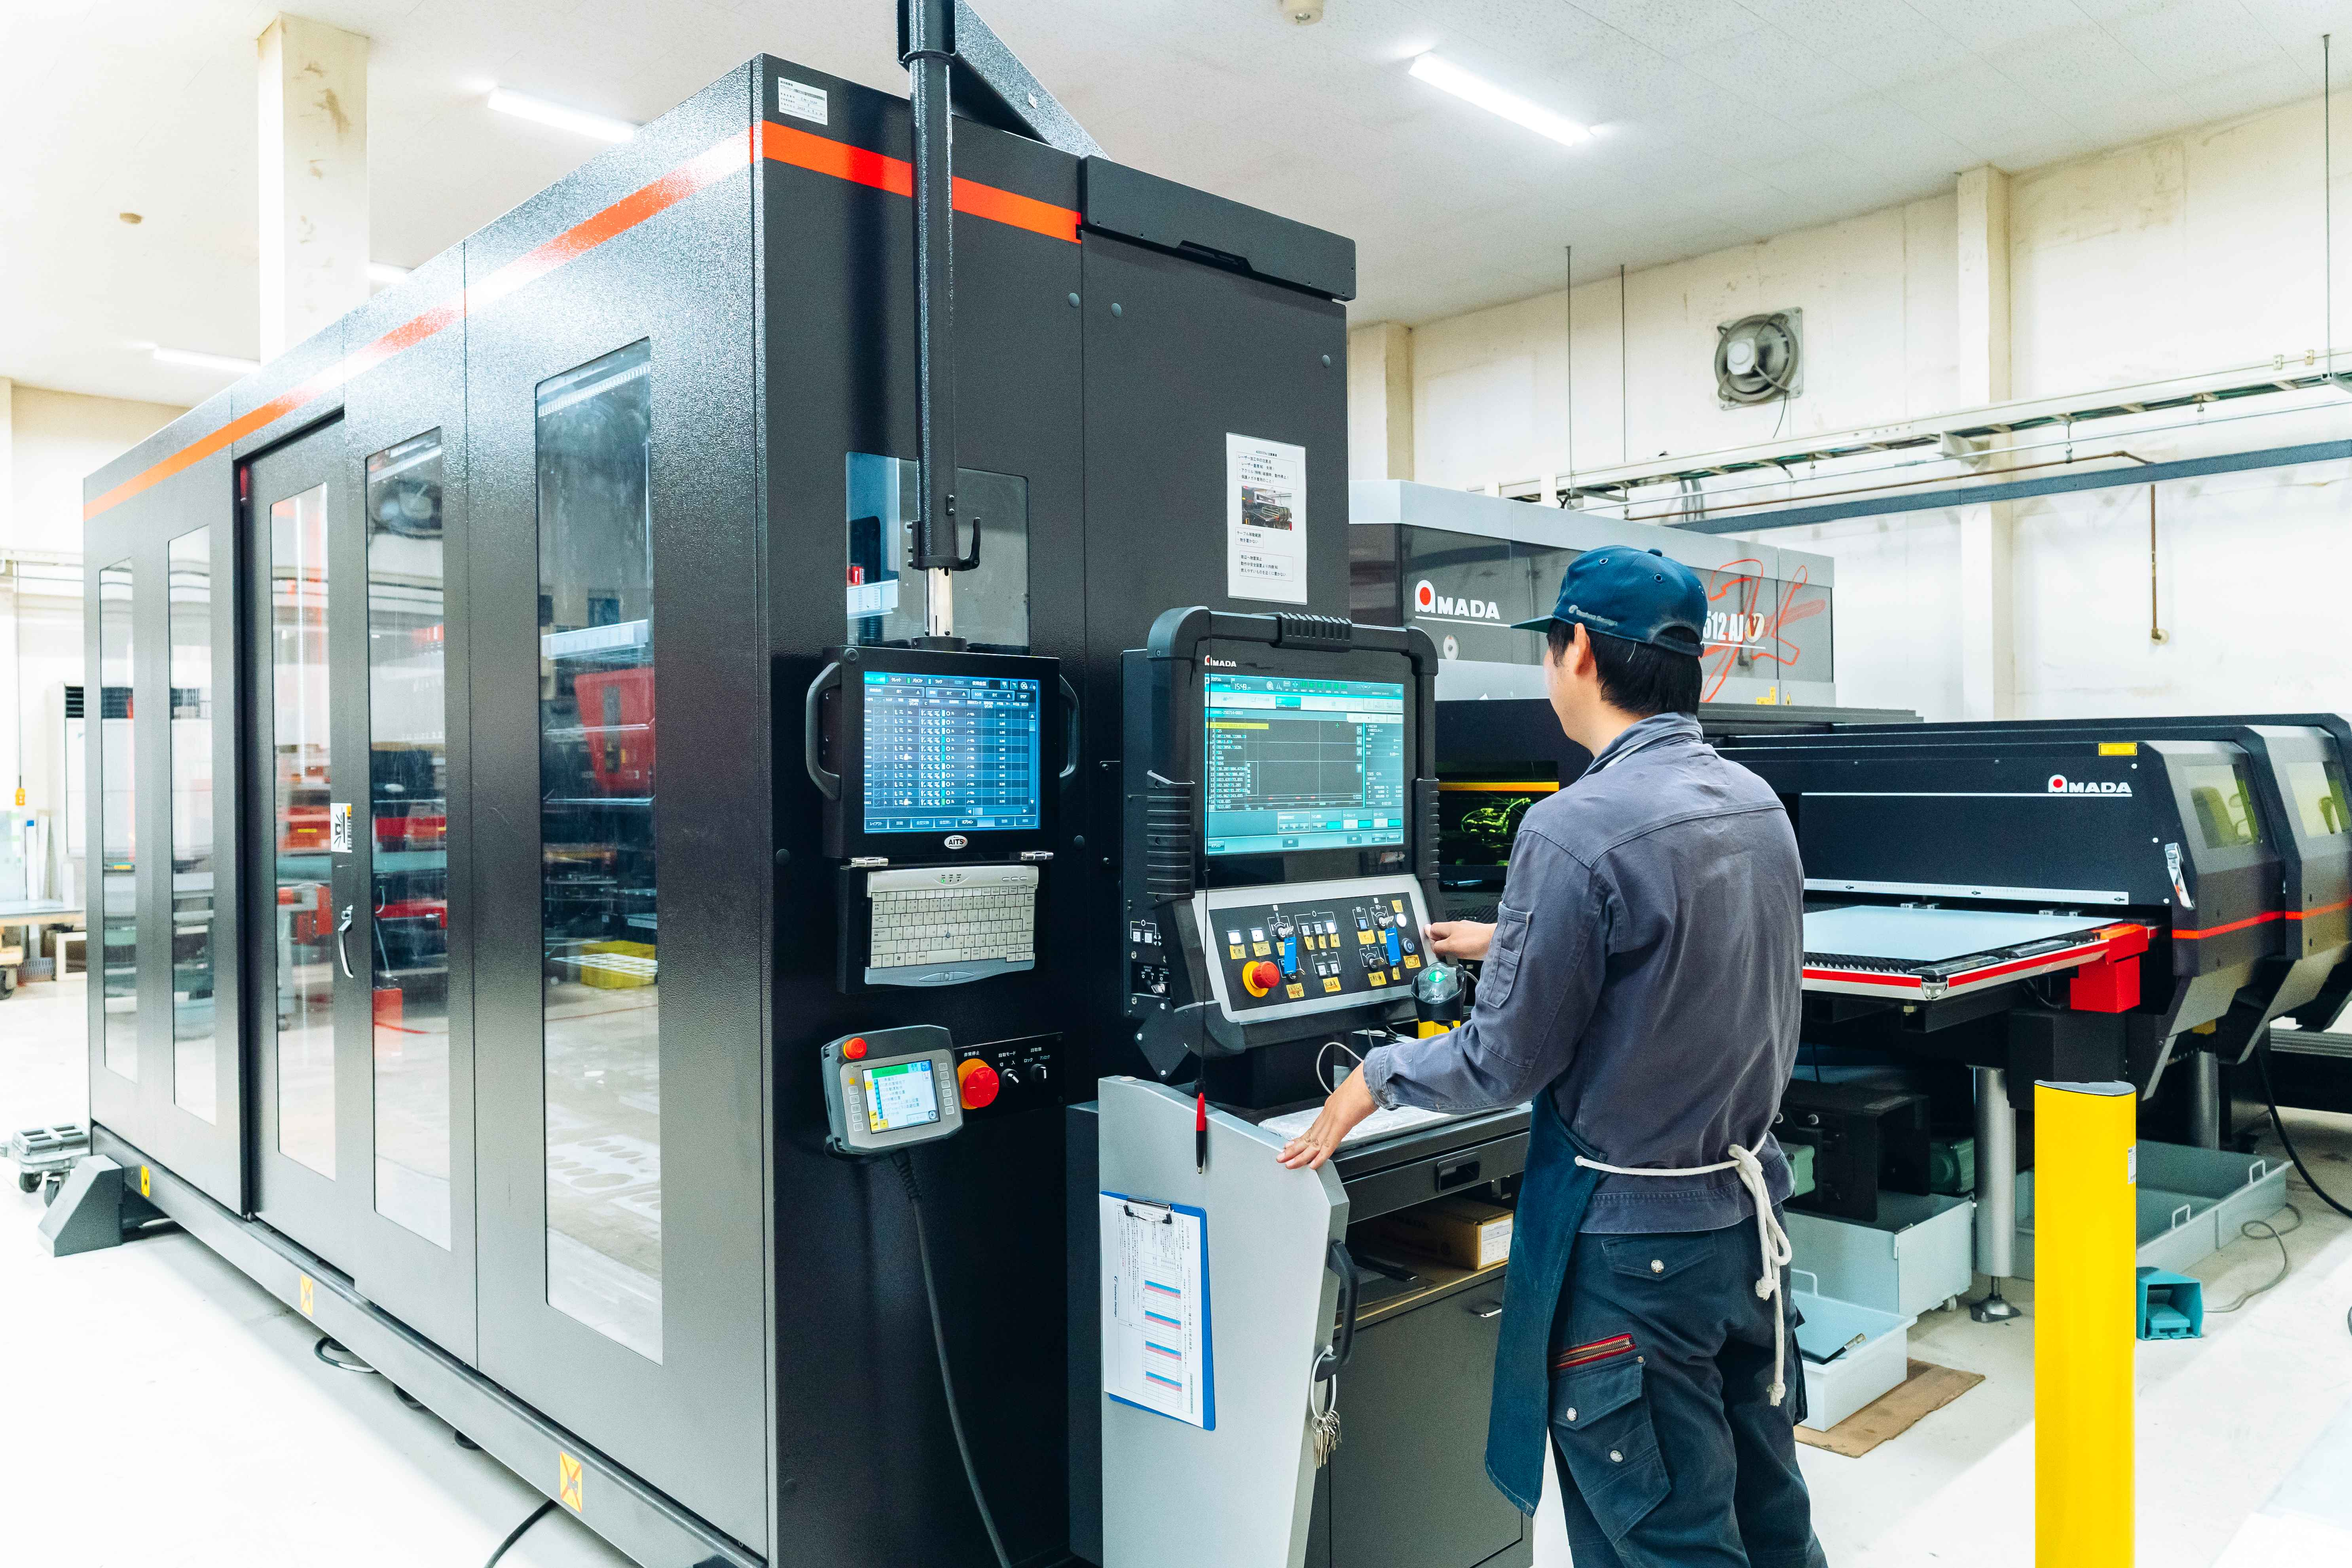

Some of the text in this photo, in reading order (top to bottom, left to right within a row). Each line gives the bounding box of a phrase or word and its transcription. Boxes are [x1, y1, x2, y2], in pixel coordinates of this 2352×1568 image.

[1415, 580, 1500, 620] AMADA
[1204, 655, 1237, 667] AMADA
[2048, 774, 2132, 793] AMADA
